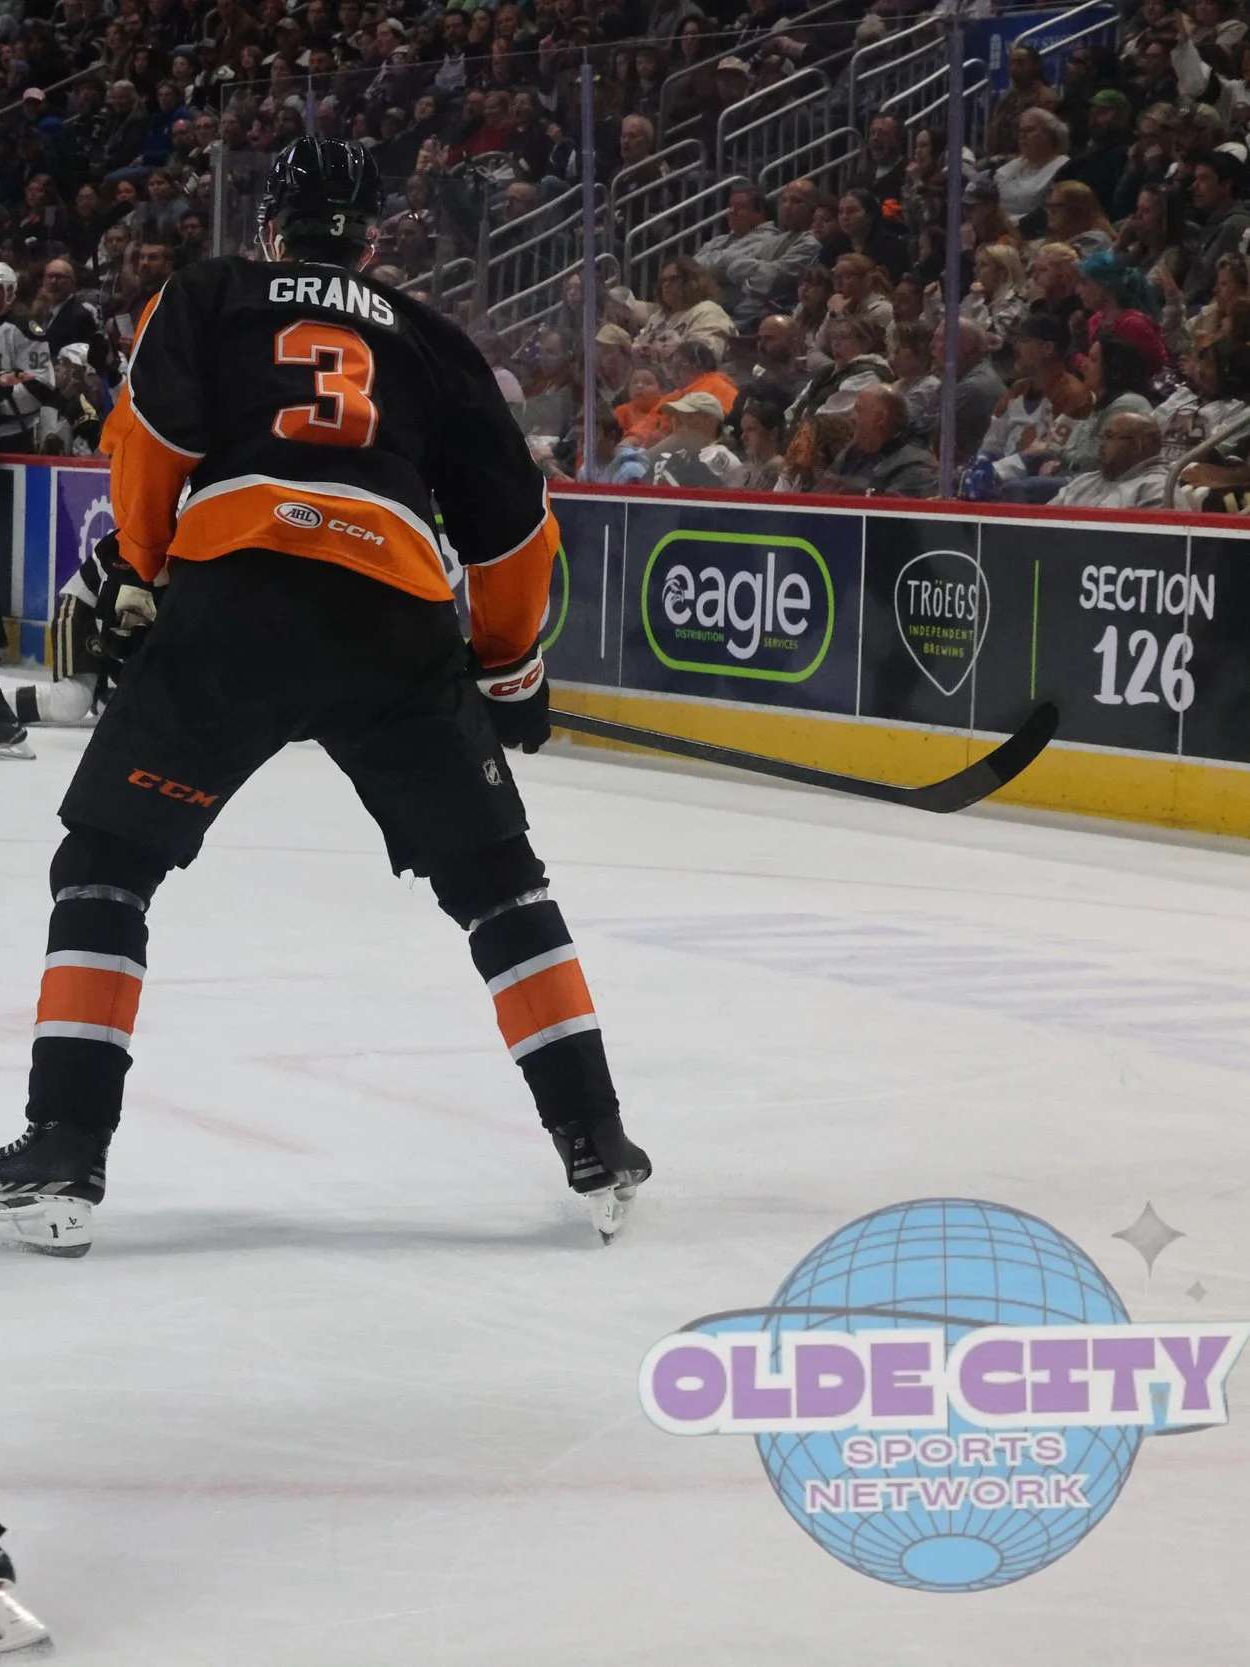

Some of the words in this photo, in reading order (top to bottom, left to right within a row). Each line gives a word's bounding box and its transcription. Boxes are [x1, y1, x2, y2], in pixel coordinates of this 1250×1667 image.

[329, 213, 345, 236] 3
[269, 277, 394, 327] GRANS
[28, 350, 49, 370] 92
[271, 319, 379, 448] 3
[285, 507, 313, 522] AHL
[327, 519, 385, 546] CCM
[662, 552, 811, 660] eagle
[907, 580, 977, 620] TRÖEGS
[1079, 565, 1215, 620] SECTION
[675, 628, 724, 643] DISTRIBUTION
[763, 636, 799, 651] SERVICES
[909, 625, 974, 642] INDEPENDENT
[923, 641, 965, 658] BREWING
[1092, 625, 1195, 712] 126
[127, 767, 220, 808] CCM
